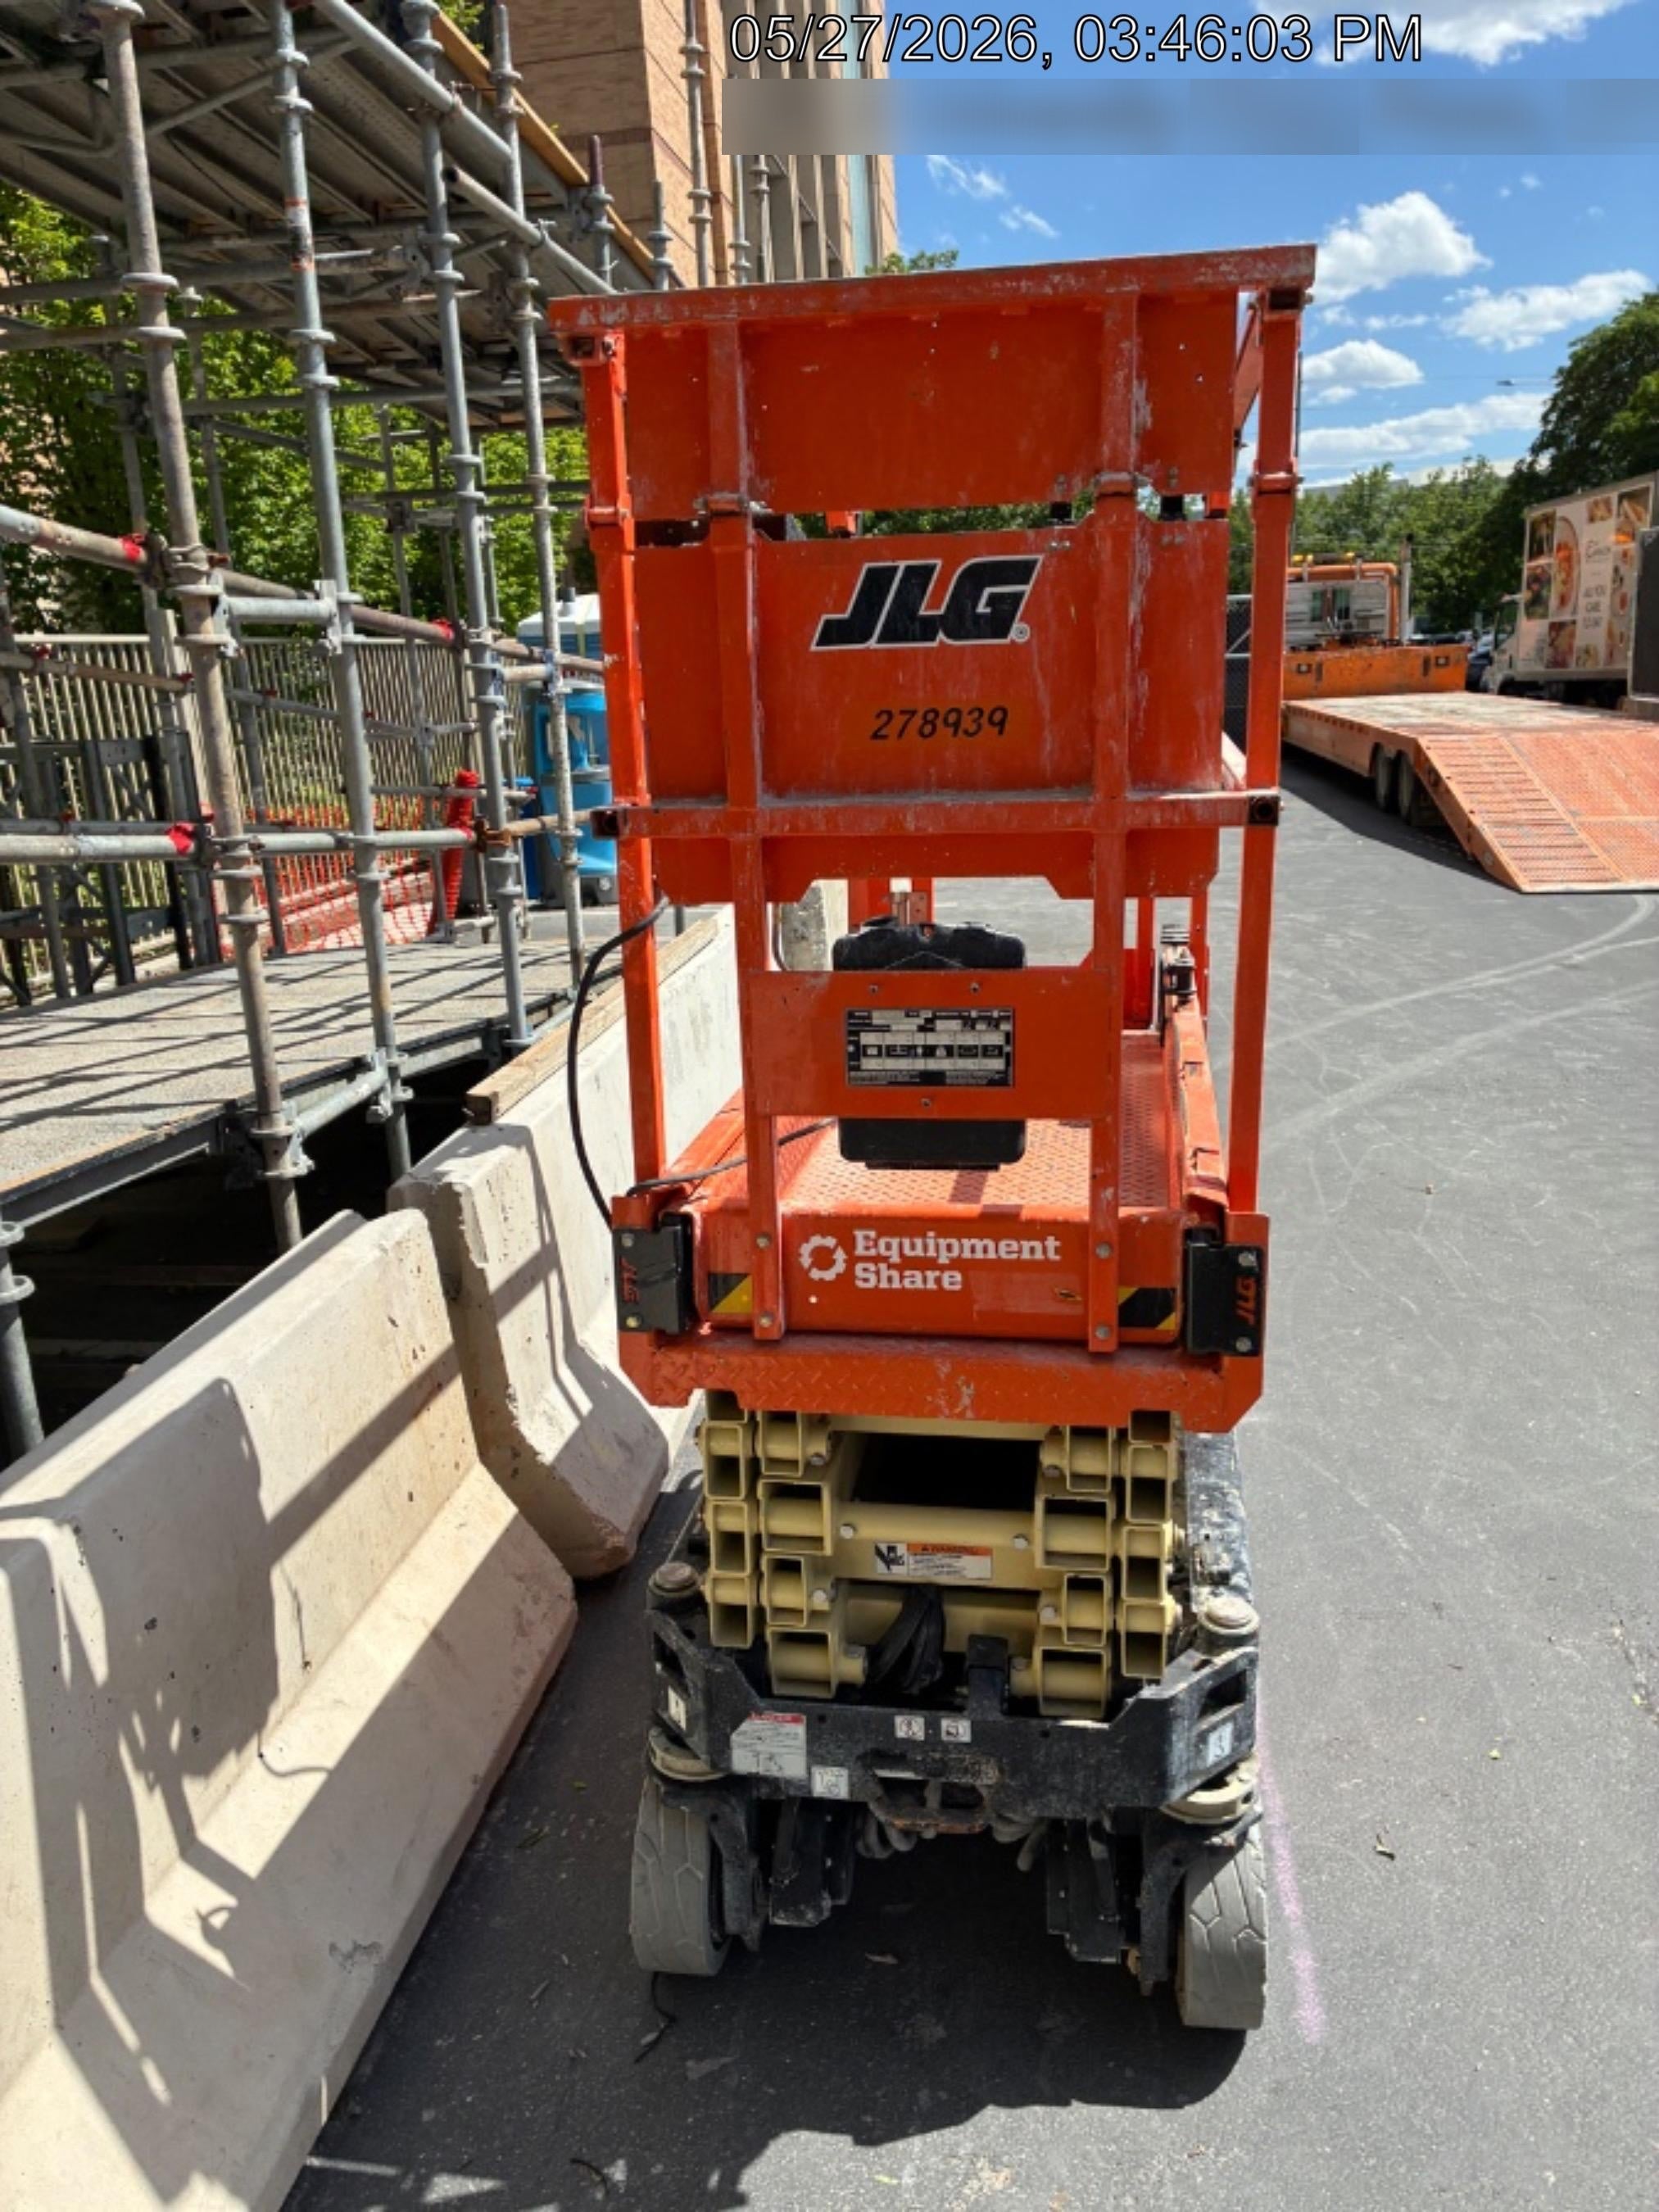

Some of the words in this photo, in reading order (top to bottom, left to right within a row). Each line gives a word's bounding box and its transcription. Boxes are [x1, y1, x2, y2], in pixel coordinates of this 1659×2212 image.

[870, 706, 1009, 741] 278939
[854, 1230, 1061, 1263] Equipment
[854, 1262, 963, 1290] Share
[1235, 1276, 1257, 1326] JLG
